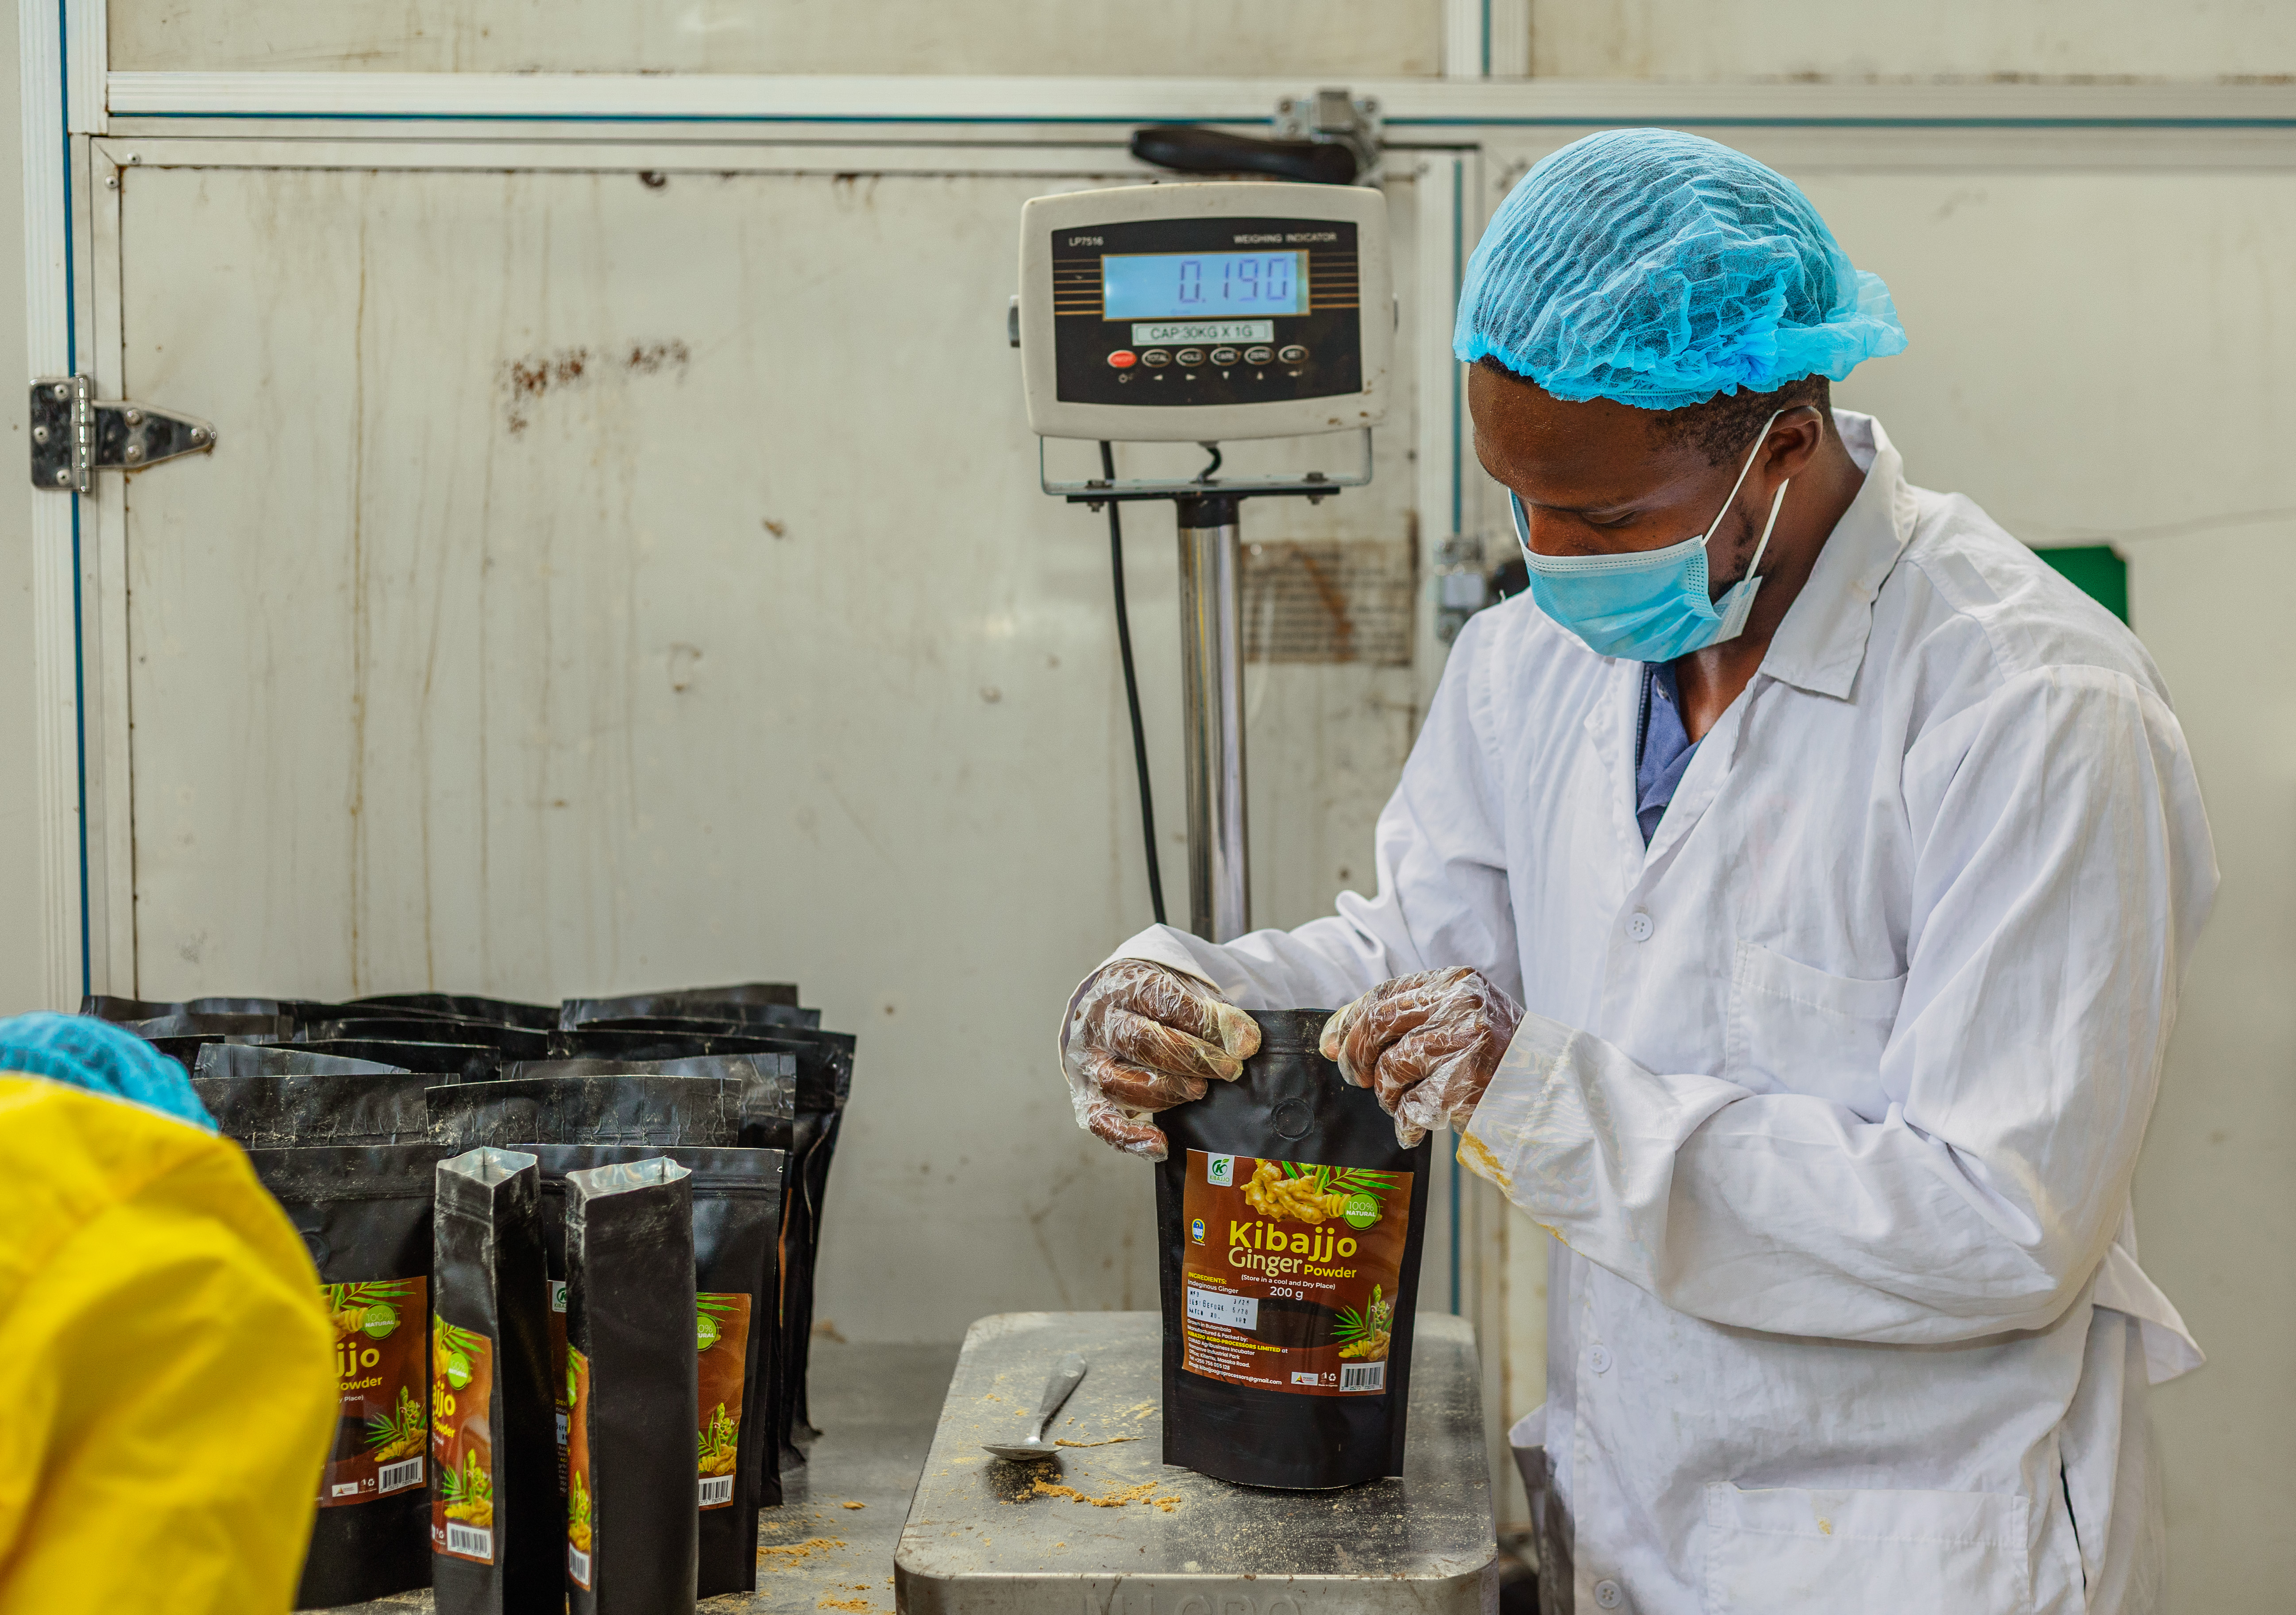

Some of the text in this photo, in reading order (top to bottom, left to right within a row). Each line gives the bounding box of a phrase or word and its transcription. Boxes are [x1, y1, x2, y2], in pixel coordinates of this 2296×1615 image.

[1069, 236, 1104, 246] LP7516
[1234, 232, 1337, 243] WEIGHING INDICATOR
[1179, 258, 1287, 303] 0.190
[1348, 1201, 1374, 1211] 100%
[1229, 1220, 1357, 1263] Kibajjo
[1228, 1247, 1357, 1278] Ginger Powder
[1188, 1271, 1227, 1284] INGREDIENTS:
[1241, 1274, 1260, 1283] (Store
[1188, 1279, 1239, 1294] Indeginous Ginger
[1270, 1286, 1304, 1301] 200 g
[367, 1312, 392, 1323] 100%
[1187, 1325, 1216, 1337] Manufactured
[1205, 1323, 1231, 1333] Butambala
[1187, 1330, 1206, 1340] KIBAJJO
[1206, 1336, 1257, 1349] AGRO-PROCESSORS
[1189, 1343, 1207, 1352] Namanve
[1207, 1348, 1228, 1357] Industrial
[1201, 1341, 1230, 1352] Agribusiness
